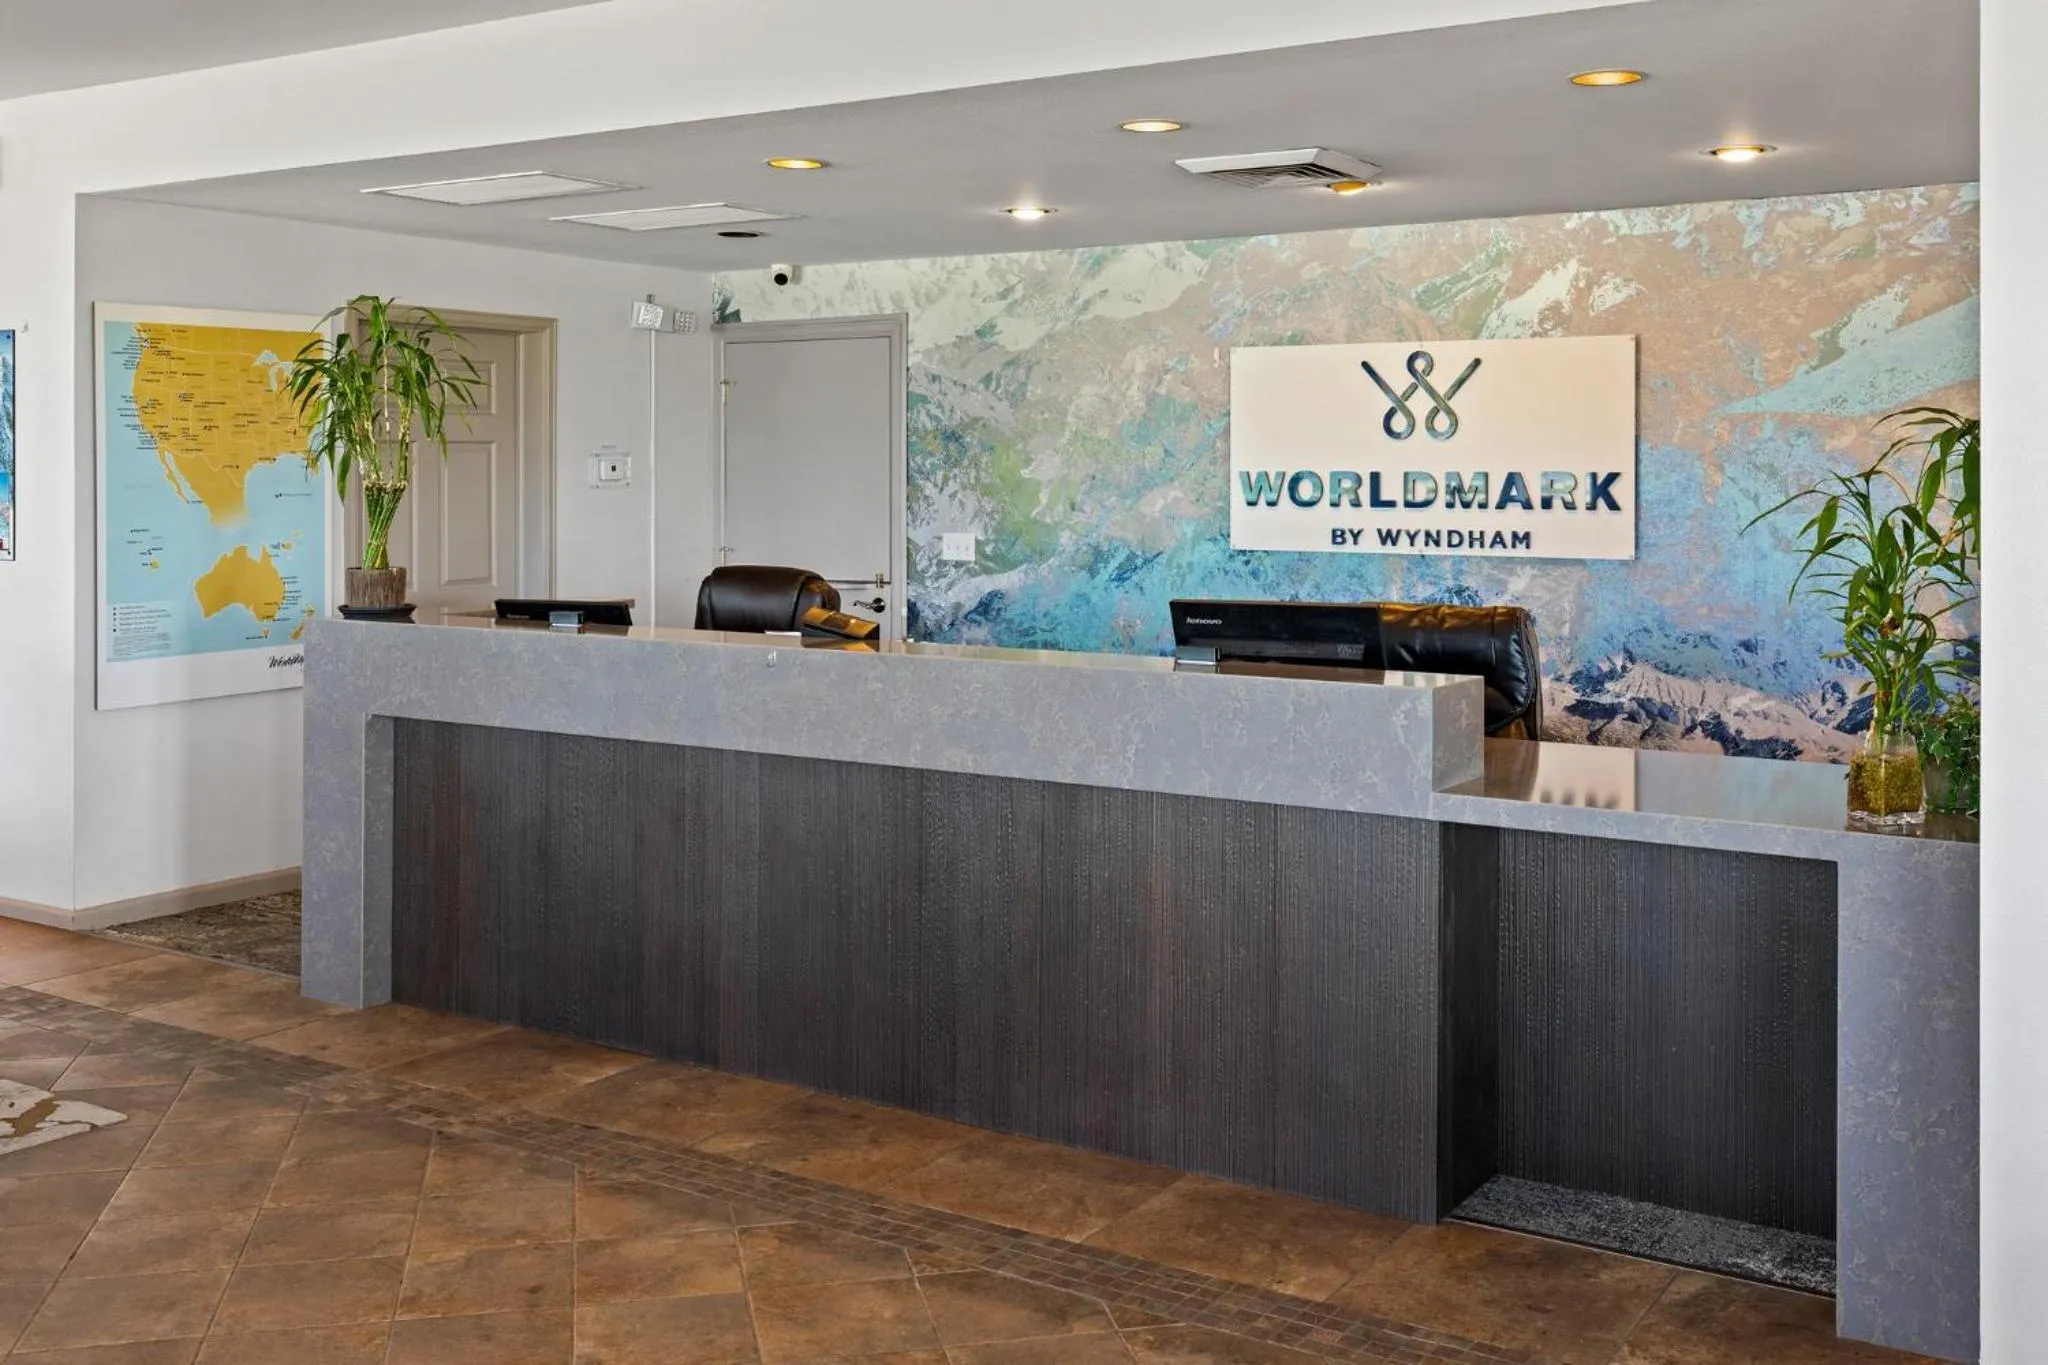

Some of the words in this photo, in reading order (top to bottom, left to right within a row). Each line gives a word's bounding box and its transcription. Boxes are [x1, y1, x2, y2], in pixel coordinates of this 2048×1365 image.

[1240, 471, 1622, 512] WORLDMARK
[1331, 528, 1366, 547] BY
[1376, 529, 1532, 550] WYNDHAM
